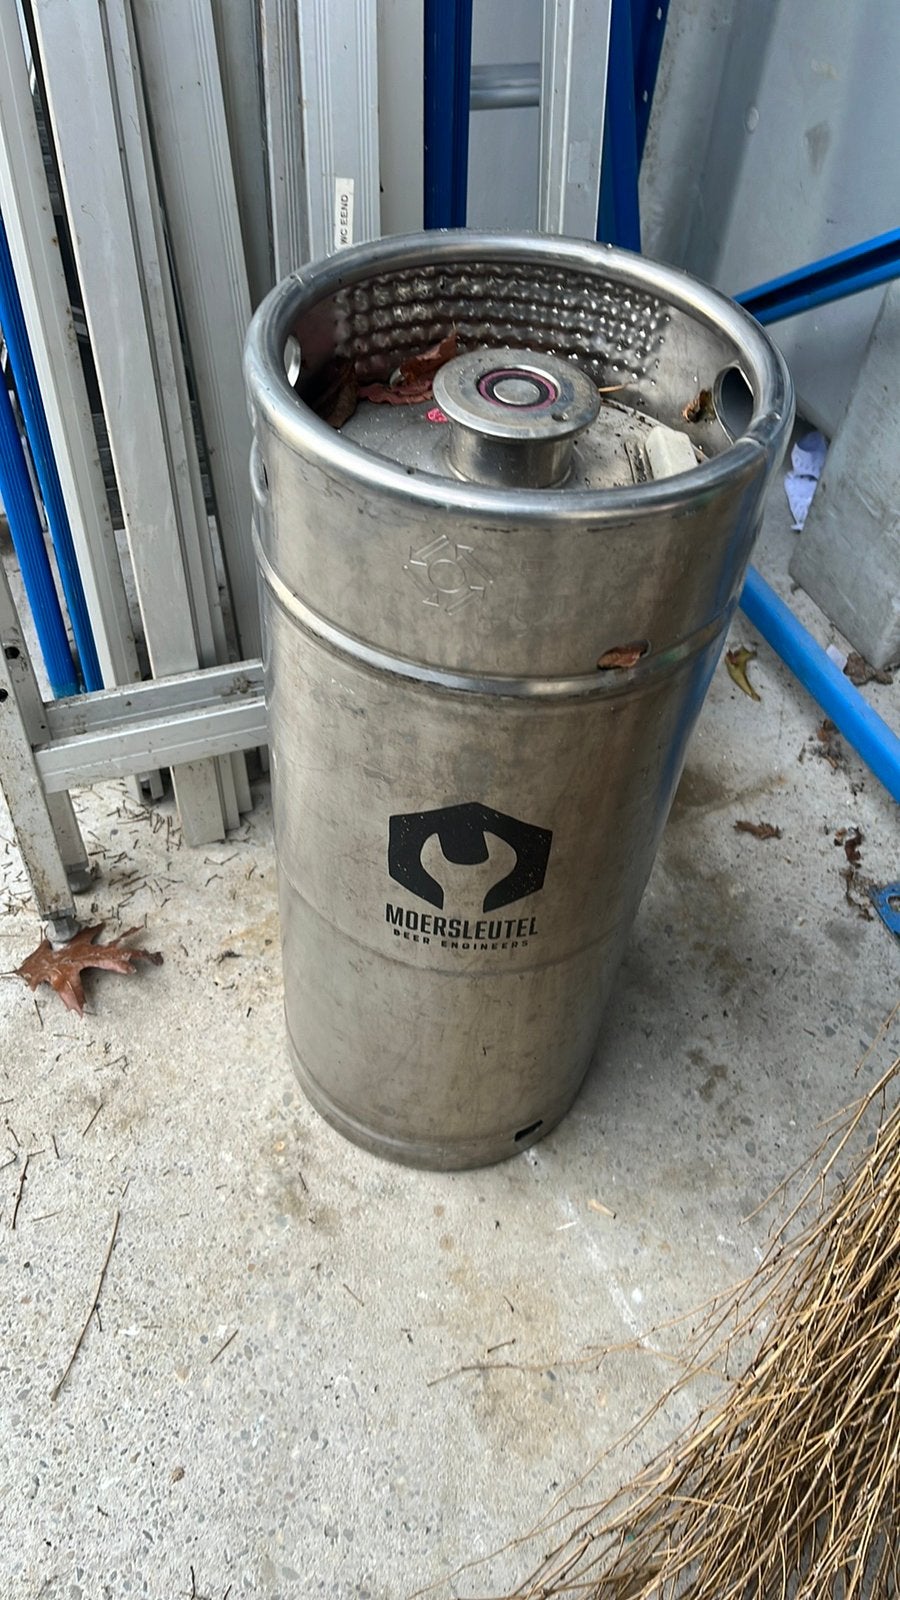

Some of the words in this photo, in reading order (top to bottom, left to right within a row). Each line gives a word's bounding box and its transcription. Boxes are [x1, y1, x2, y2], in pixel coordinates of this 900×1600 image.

[340, 194, 348, 226] EEND
[340, 229, 348, 245] WC
[385, 903, 538, 940] MOERSLEUTEL
[393, 928, 430, 945] BEER
[441, 940, 528, 950] ENGINEERS
